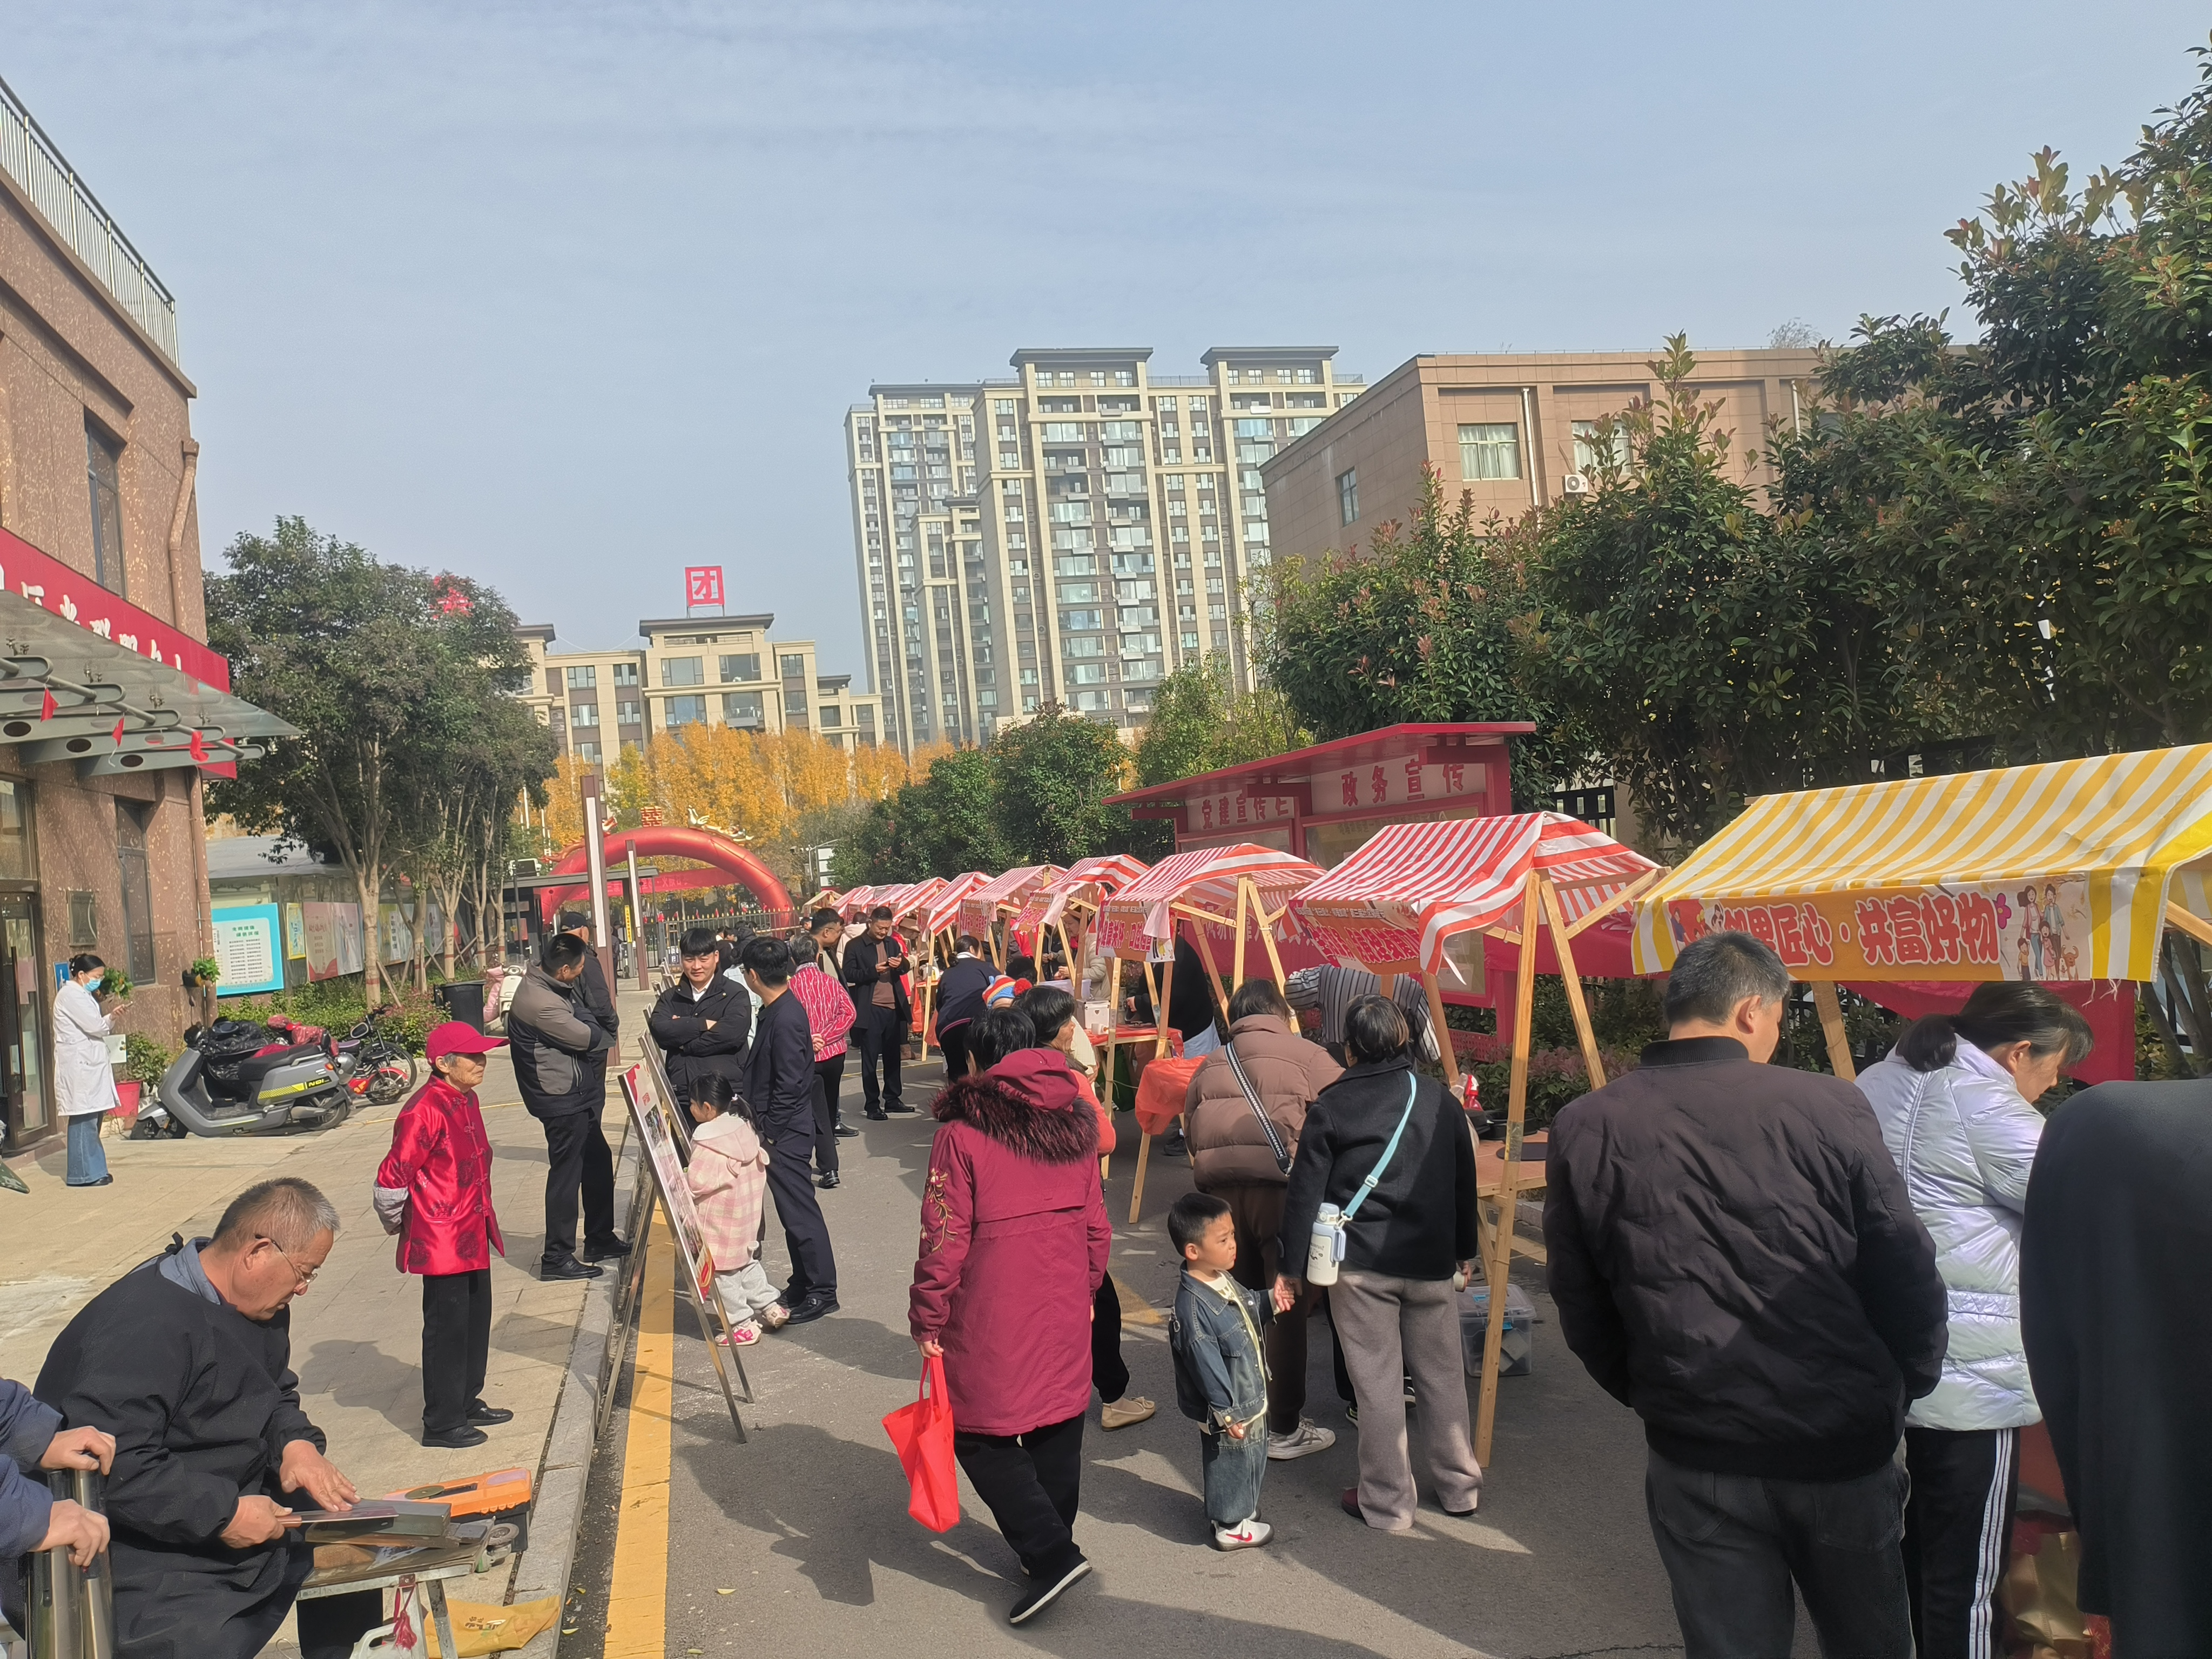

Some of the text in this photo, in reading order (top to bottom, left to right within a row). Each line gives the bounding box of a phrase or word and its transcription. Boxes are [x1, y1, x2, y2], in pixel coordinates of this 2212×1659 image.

[684, 565, 725, 606] 团
[1341, 758, 1465, 807] 政务宣传
